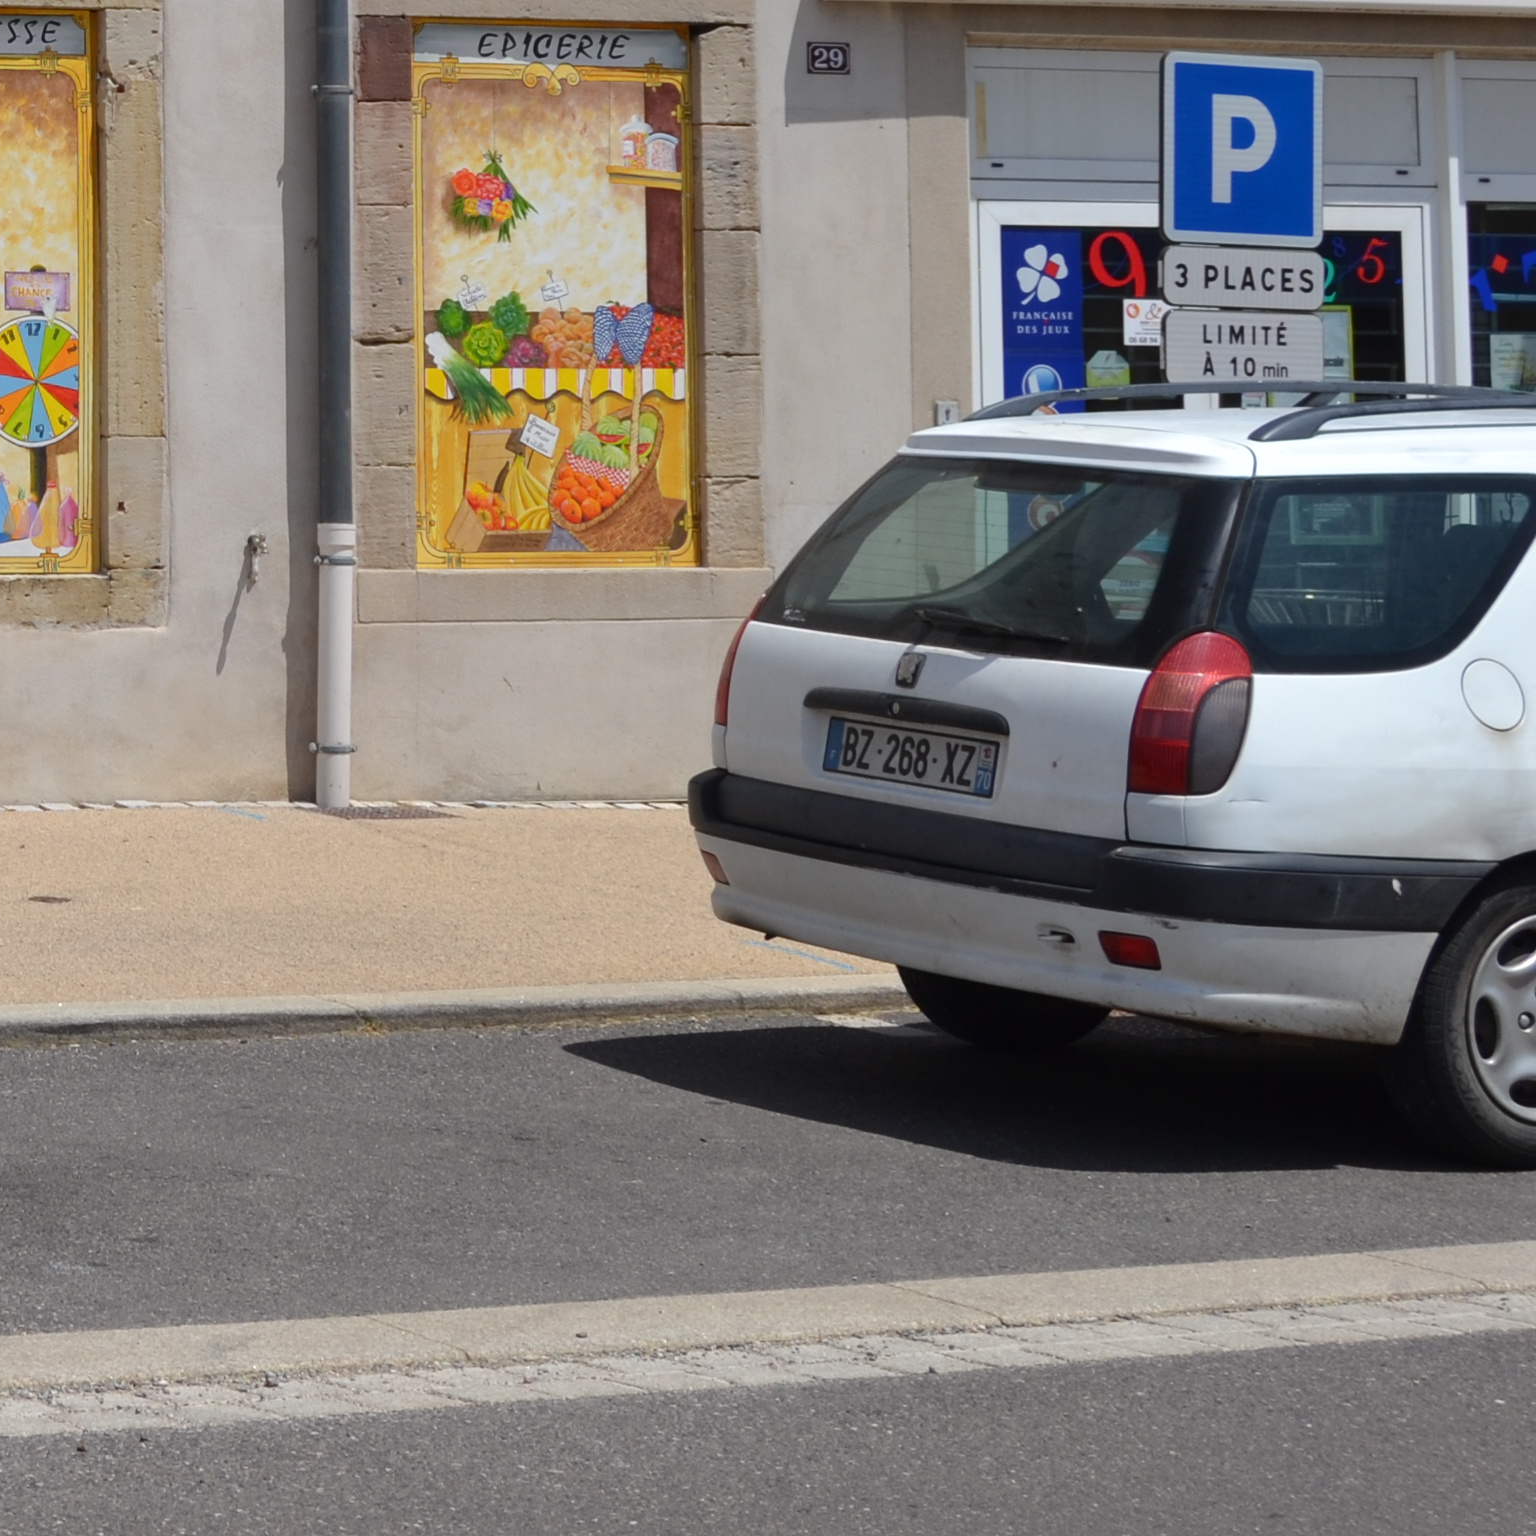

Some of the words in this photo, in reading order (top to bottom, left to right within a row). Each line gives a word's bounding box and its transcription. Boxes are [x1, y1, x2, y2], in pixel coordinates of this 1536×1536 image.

[477, 31, 631, 60] EPICERIE
[813, 47, 844, 69] 29
[1211, 93, 1277, 204] P
[1088, 229, 1147, 298] 9
[1356, 237, 1390, 284] 5
[1174, 263, 1189, 289] 3
[1203, 264, 1315, 294] PLACES
[1016, 325, 1038, 334] DES
[1041, 325, 1070, 336] JEUX
[1202, 321, 1288, 347] LIMITÉ
[1202, 350, 1216, 376] À
[1229, 356, 1256, 378] 10
[1262, 363, 1289, 379] min
[976, 770, 991, 791] 70
